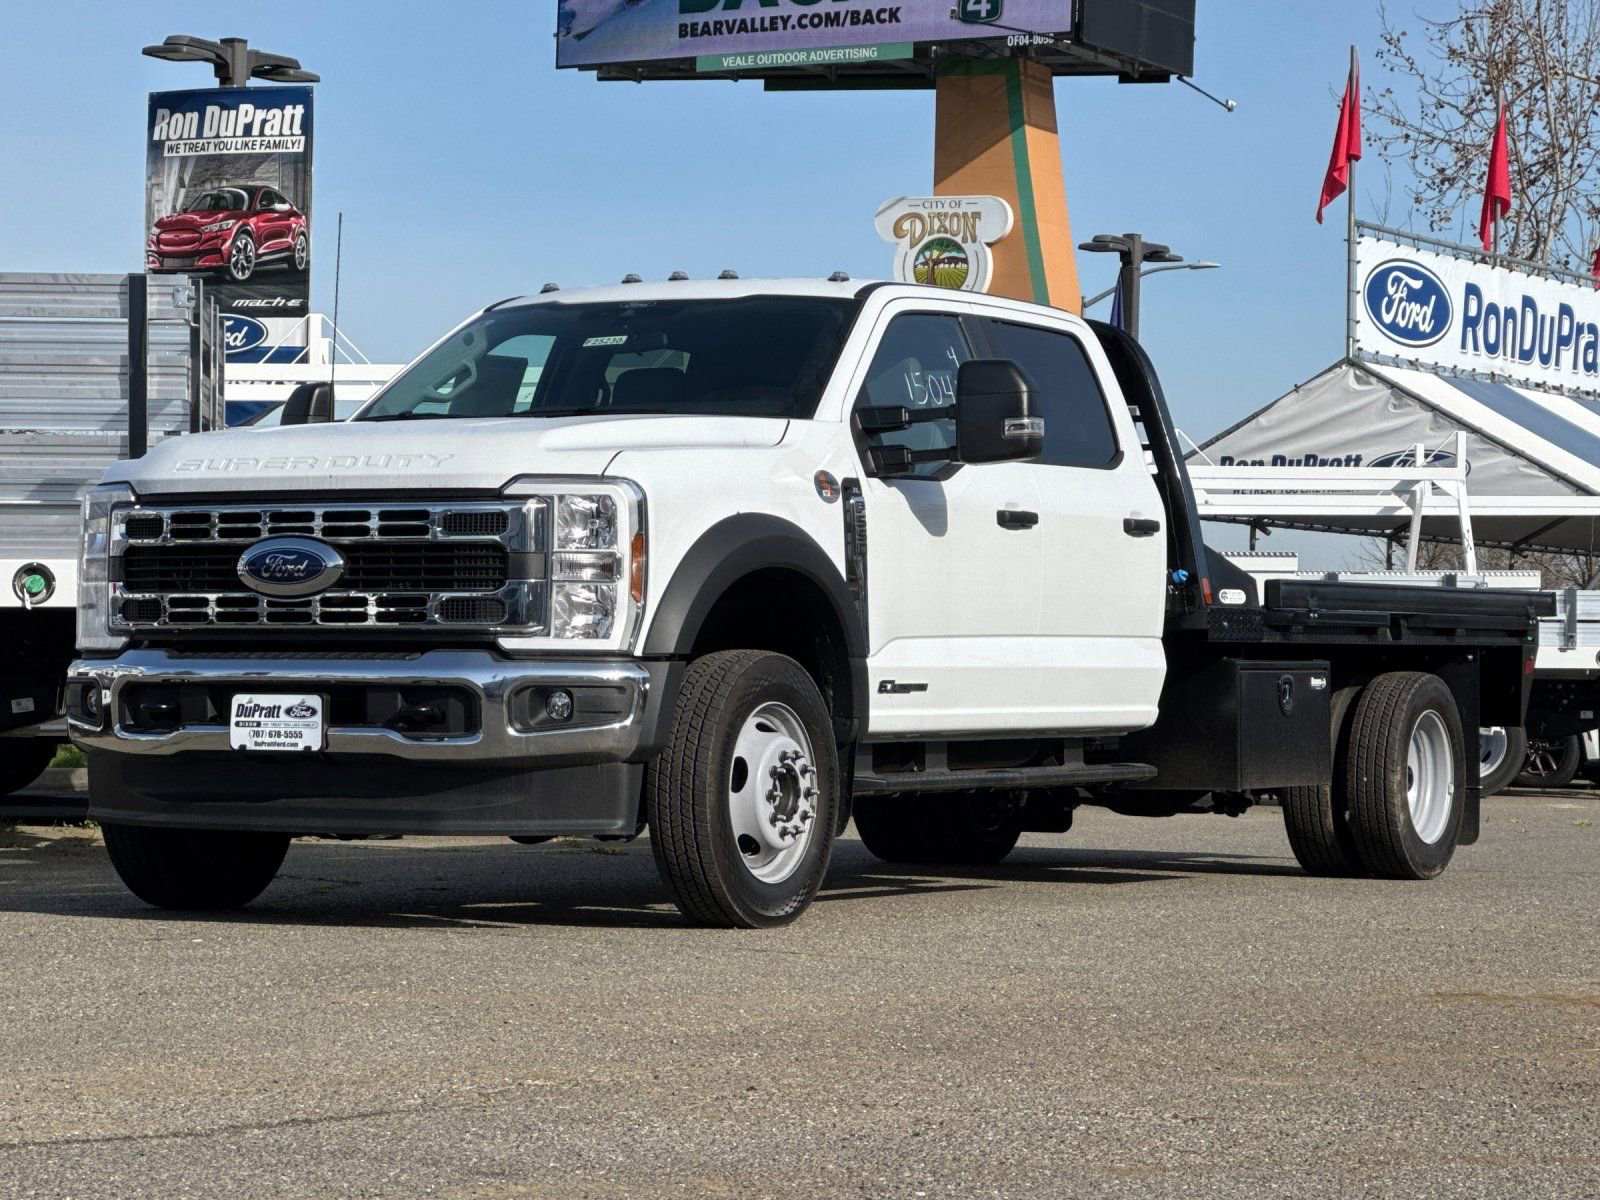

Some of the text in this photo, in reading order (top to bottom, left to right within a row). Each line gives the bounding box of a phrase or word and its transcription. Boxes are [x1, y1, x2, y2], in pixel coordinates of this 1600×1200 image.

[678, 7, 902, 38] BEARVALLEY.COM/BACK
[722, 47, 878, 67] VEALE OUTDOOR ADVERTISING
[152, 103, 304, 140] Ron DuPratt
[167, 138, 301, 154] WE TREAT YOU LIKE FAMILY!
[922, 200, 963, 209] CITY OF
[1381, 270, 1436, 333] Ford
[173, 453, 456, 472] SUPER DUTY
[260, 553, 306, 578] Ford
[235, 703, 282, 718] DuPratt
[248, 730, 267, 739] (707)
